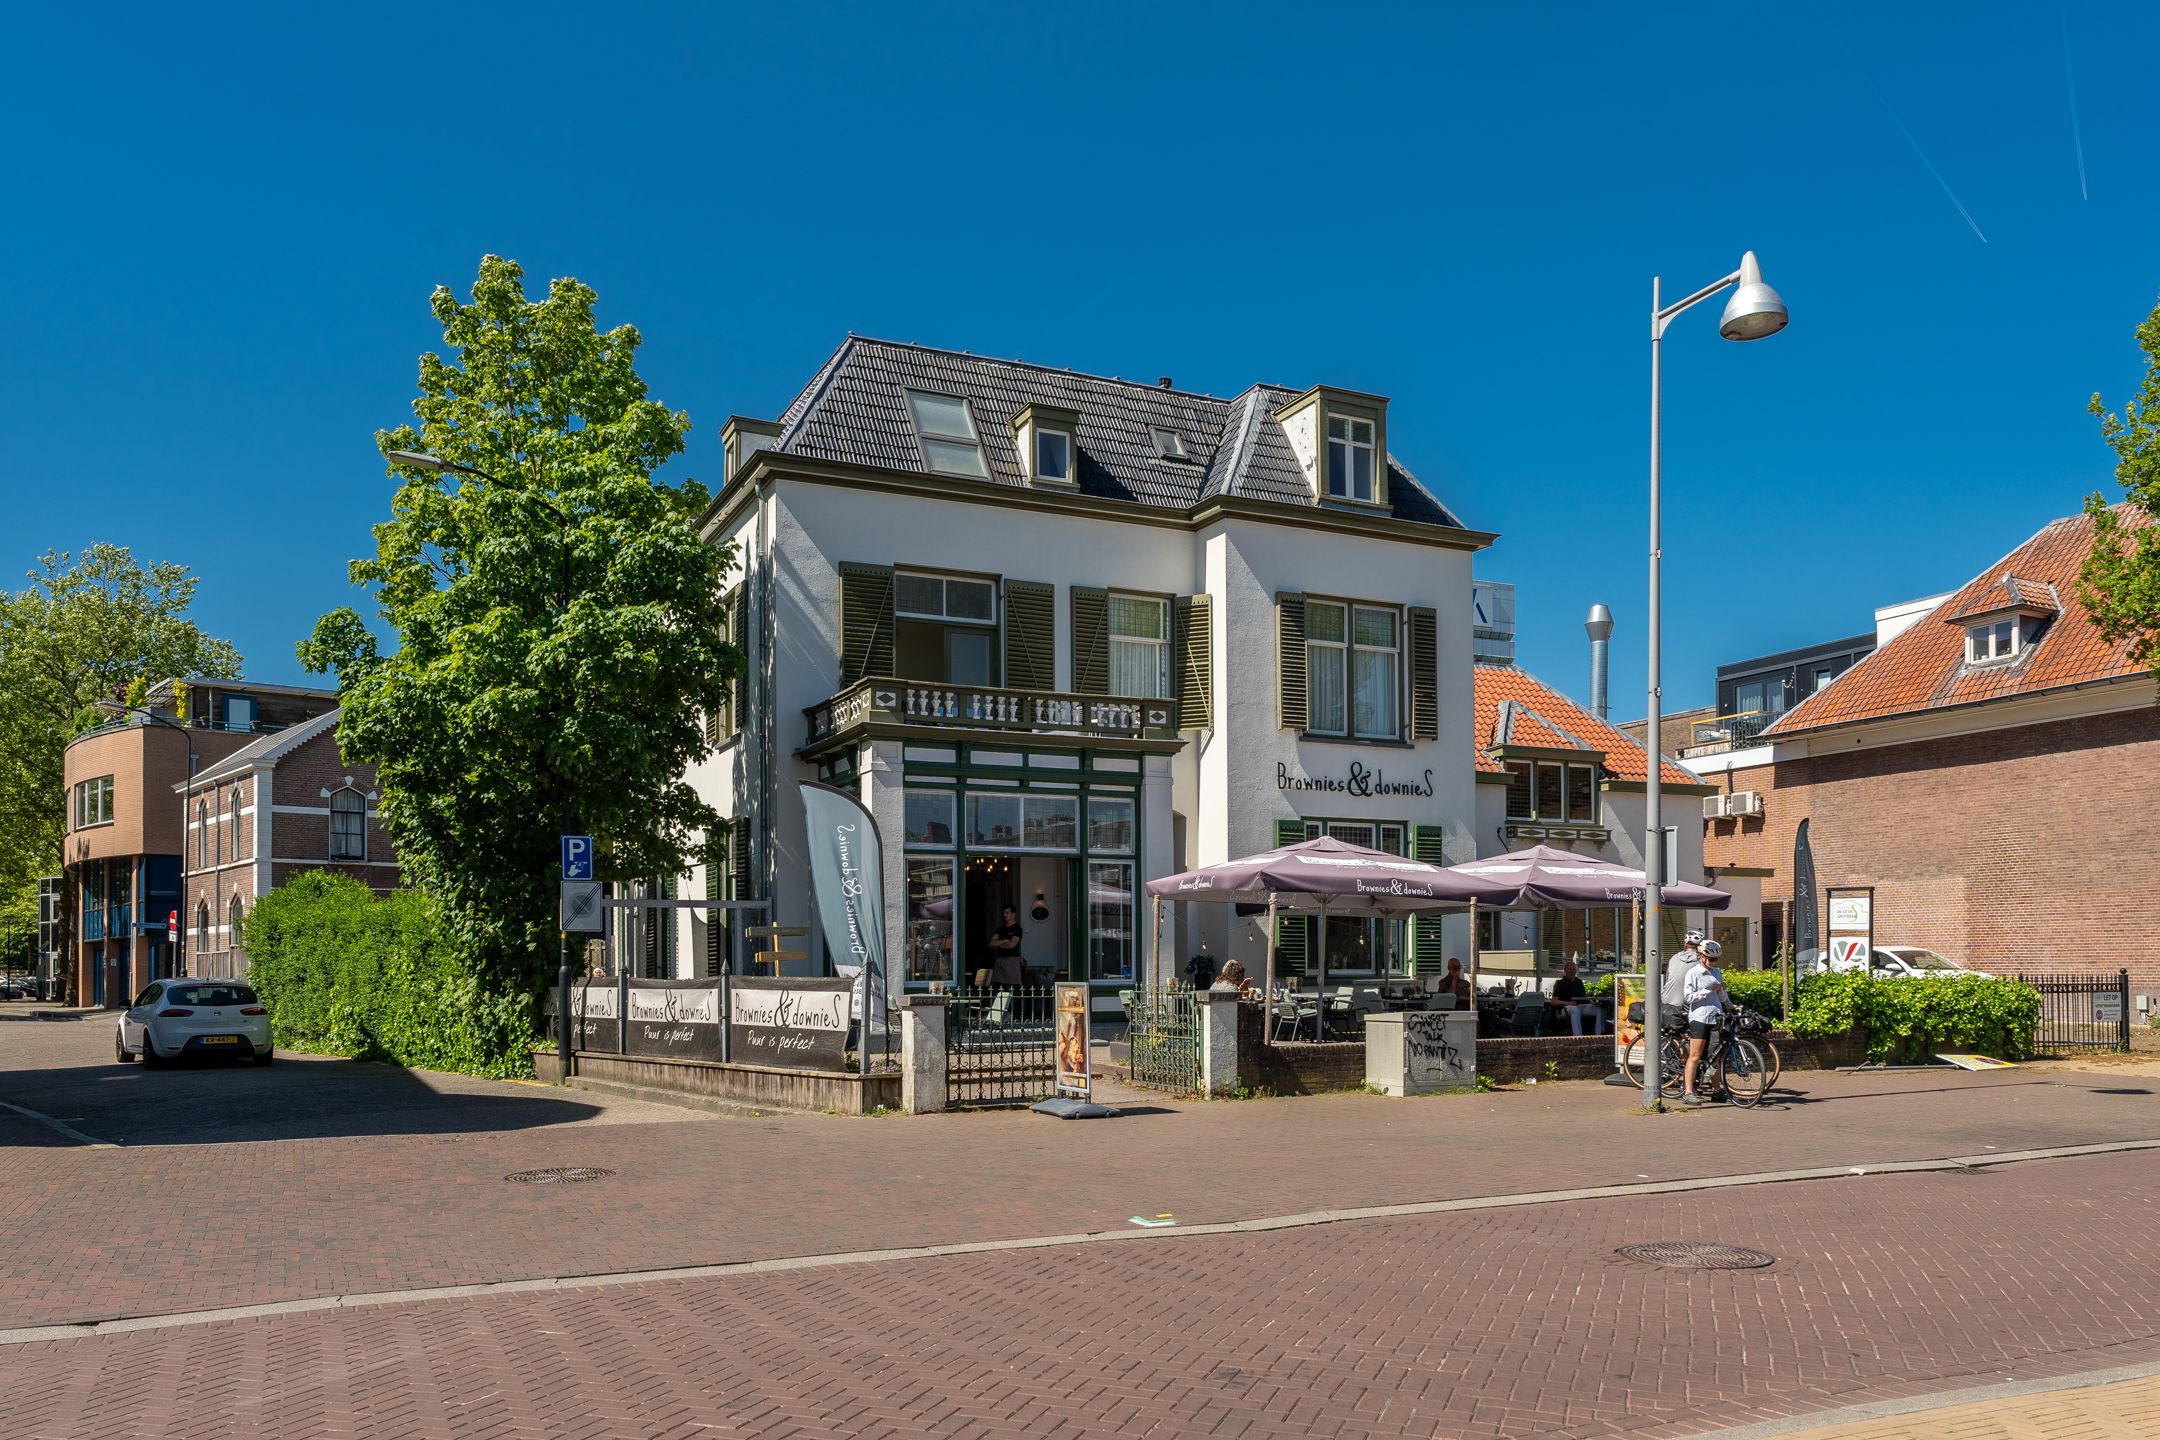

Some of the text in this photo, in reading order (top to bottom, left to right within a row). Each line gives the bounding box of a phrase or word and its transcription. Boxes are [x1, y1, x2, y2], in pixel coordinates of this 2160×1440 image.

[1277, 761, 1344, 792] Brownies
[1347, 761, 1373, 797] &
[569, 839, 586, 862] P
[1356, 879, 1390, 893] Brownies
[1390, 878, 1404, 895] &
[585, 989, 612, 1017] ownieS
[632, 992, 663, 1019] Brownies
[665, 988, 679, 1023] &
[736, 993, 773, 1023] Brownies
[774, 990, 794, 1028] &
[664, 1030, 669, 1040] is
[669, 1027, 695, 1046] perfect
[769, 1035, 776, 1046] is
[778, 1033, 815, 1054] perfect
